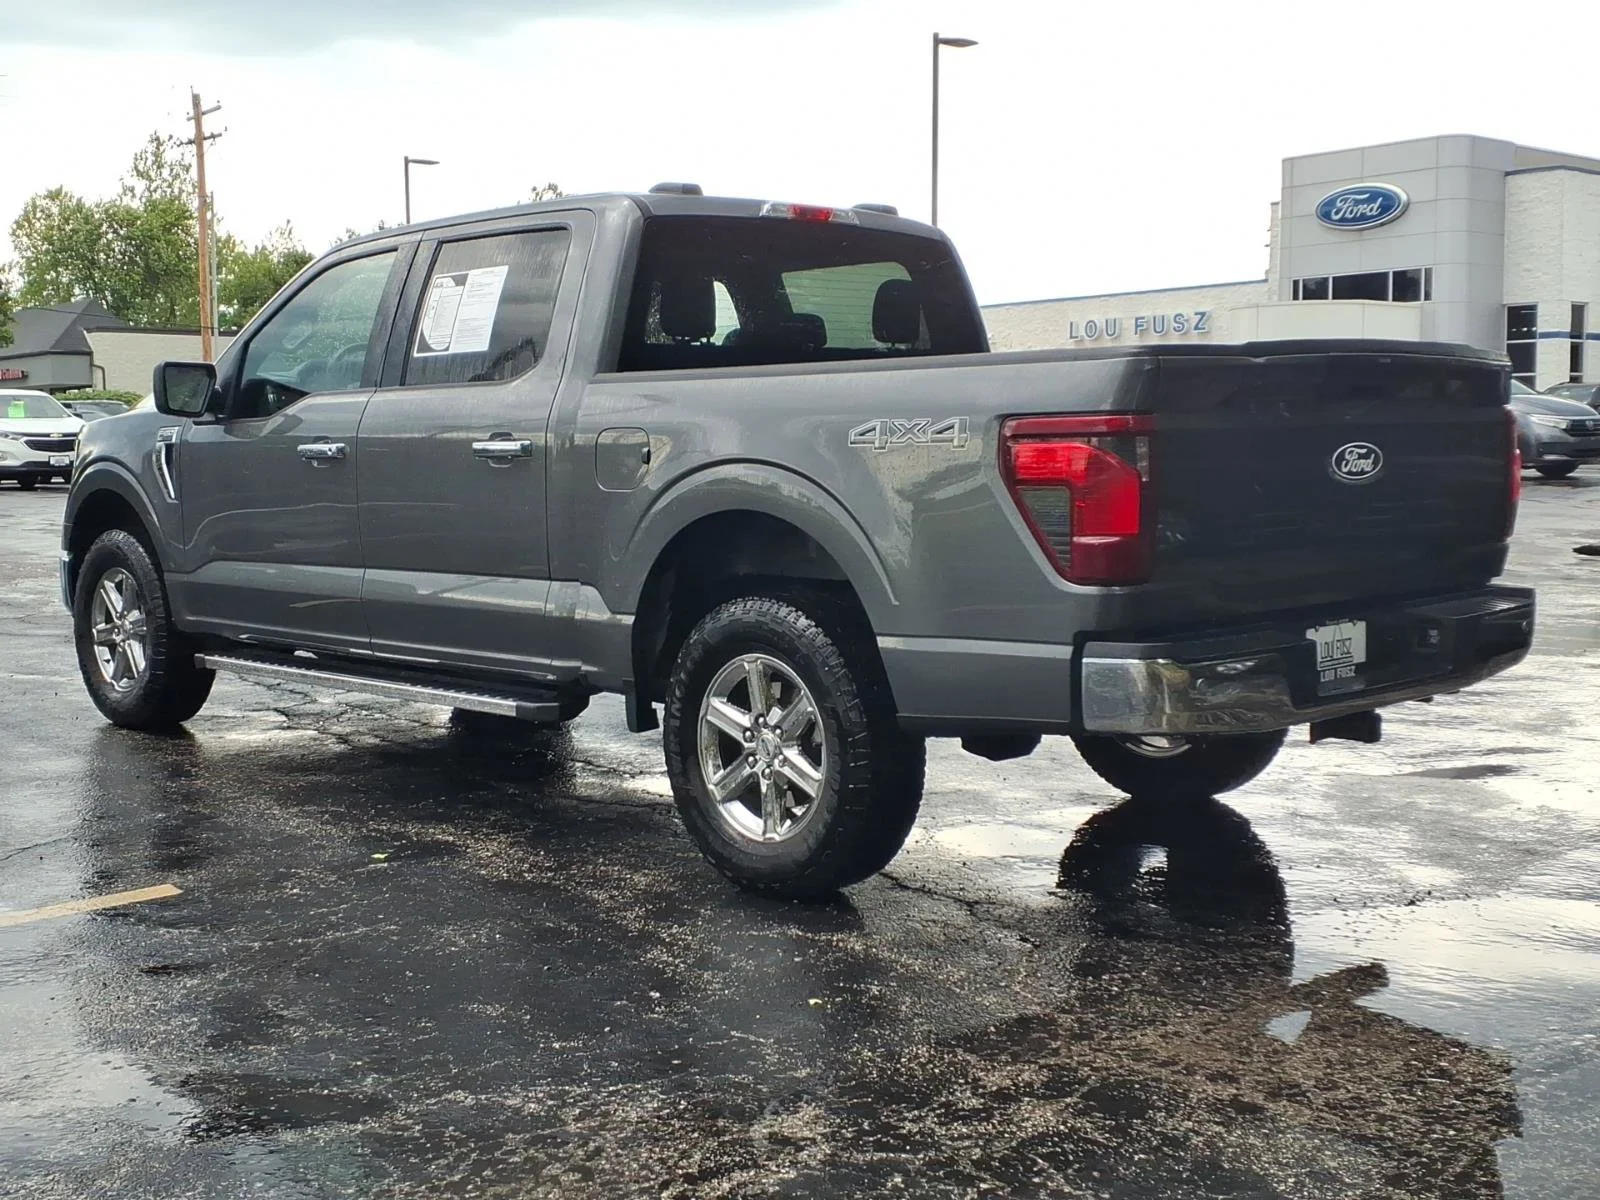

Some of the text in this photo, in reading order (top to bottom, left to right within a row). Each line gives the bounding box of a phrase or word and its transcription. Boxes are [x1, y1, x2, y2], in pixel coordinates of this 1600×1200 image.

[1331, 193, 1381, 220] Ford
[1069, 311, 1211, 340] LOU FUSZ
[1341, 447, 1375, 472] Ford
[1320, 665, 1356, 682] LOU FUSZ
